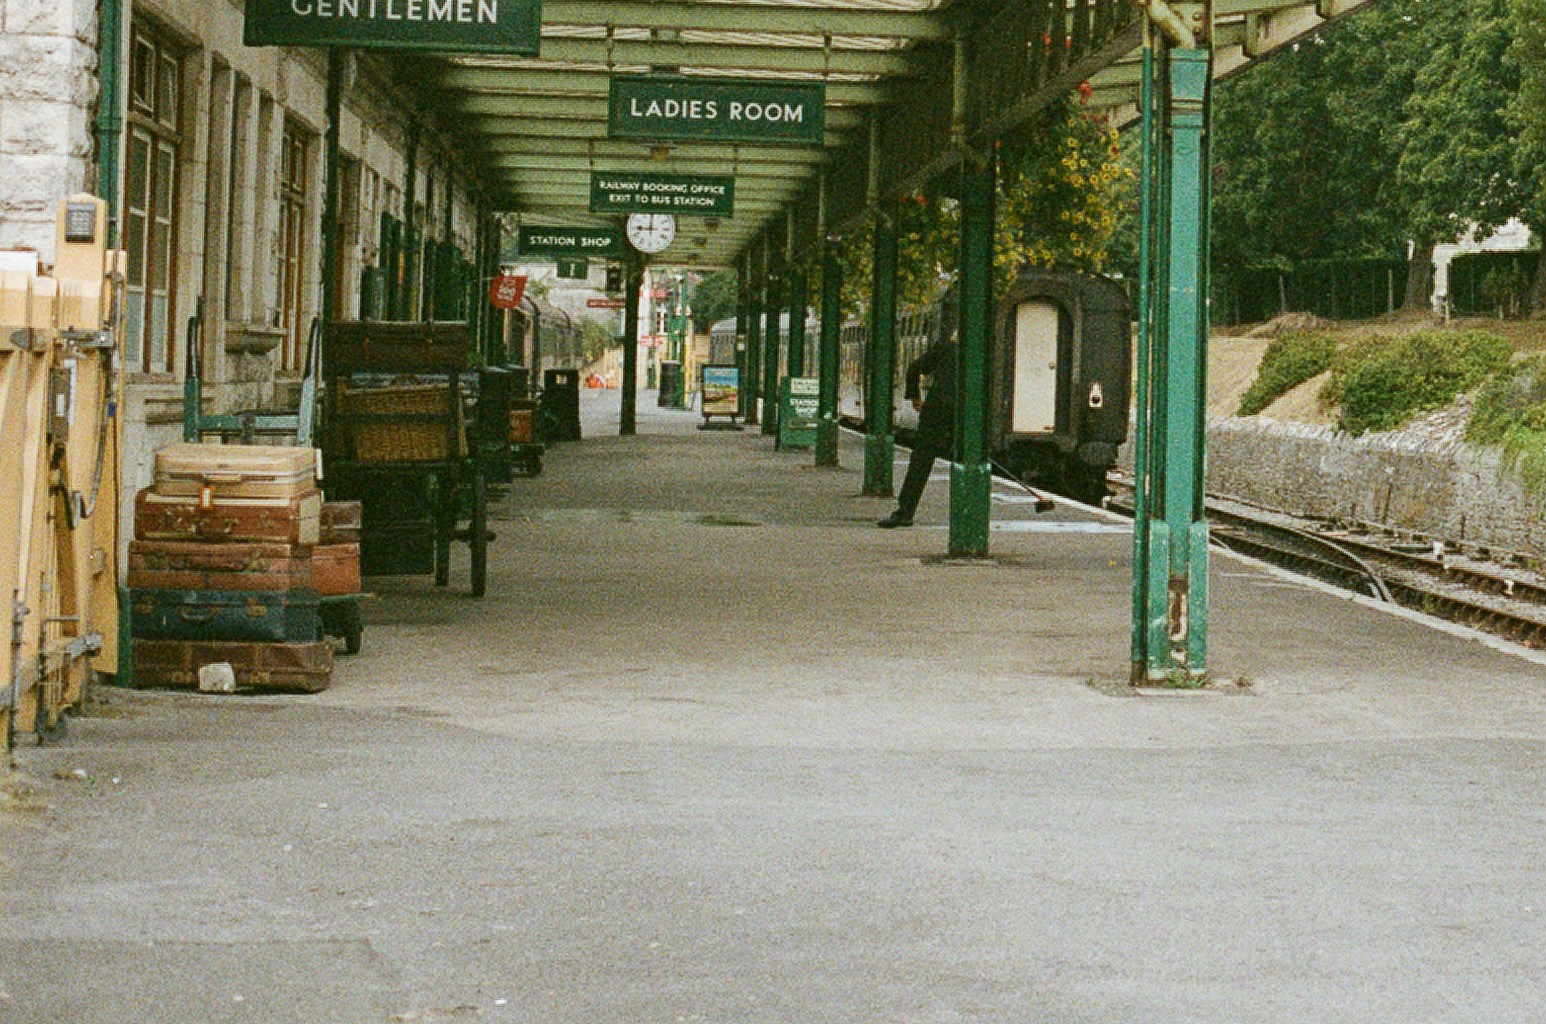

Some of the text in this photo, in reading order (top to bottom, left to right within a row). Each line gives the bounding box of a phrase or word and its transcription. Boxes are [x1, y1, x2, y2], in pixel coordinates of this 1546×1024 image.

[631, 98, 804, 123] LADIES ROOM
[599, 181, 725, 195] RAILWAY BOOKING OFFICE
[608, 194, 714, 207] EXIT TO BUS STATION
[529, 236, 612, 247] STATION SHOP
